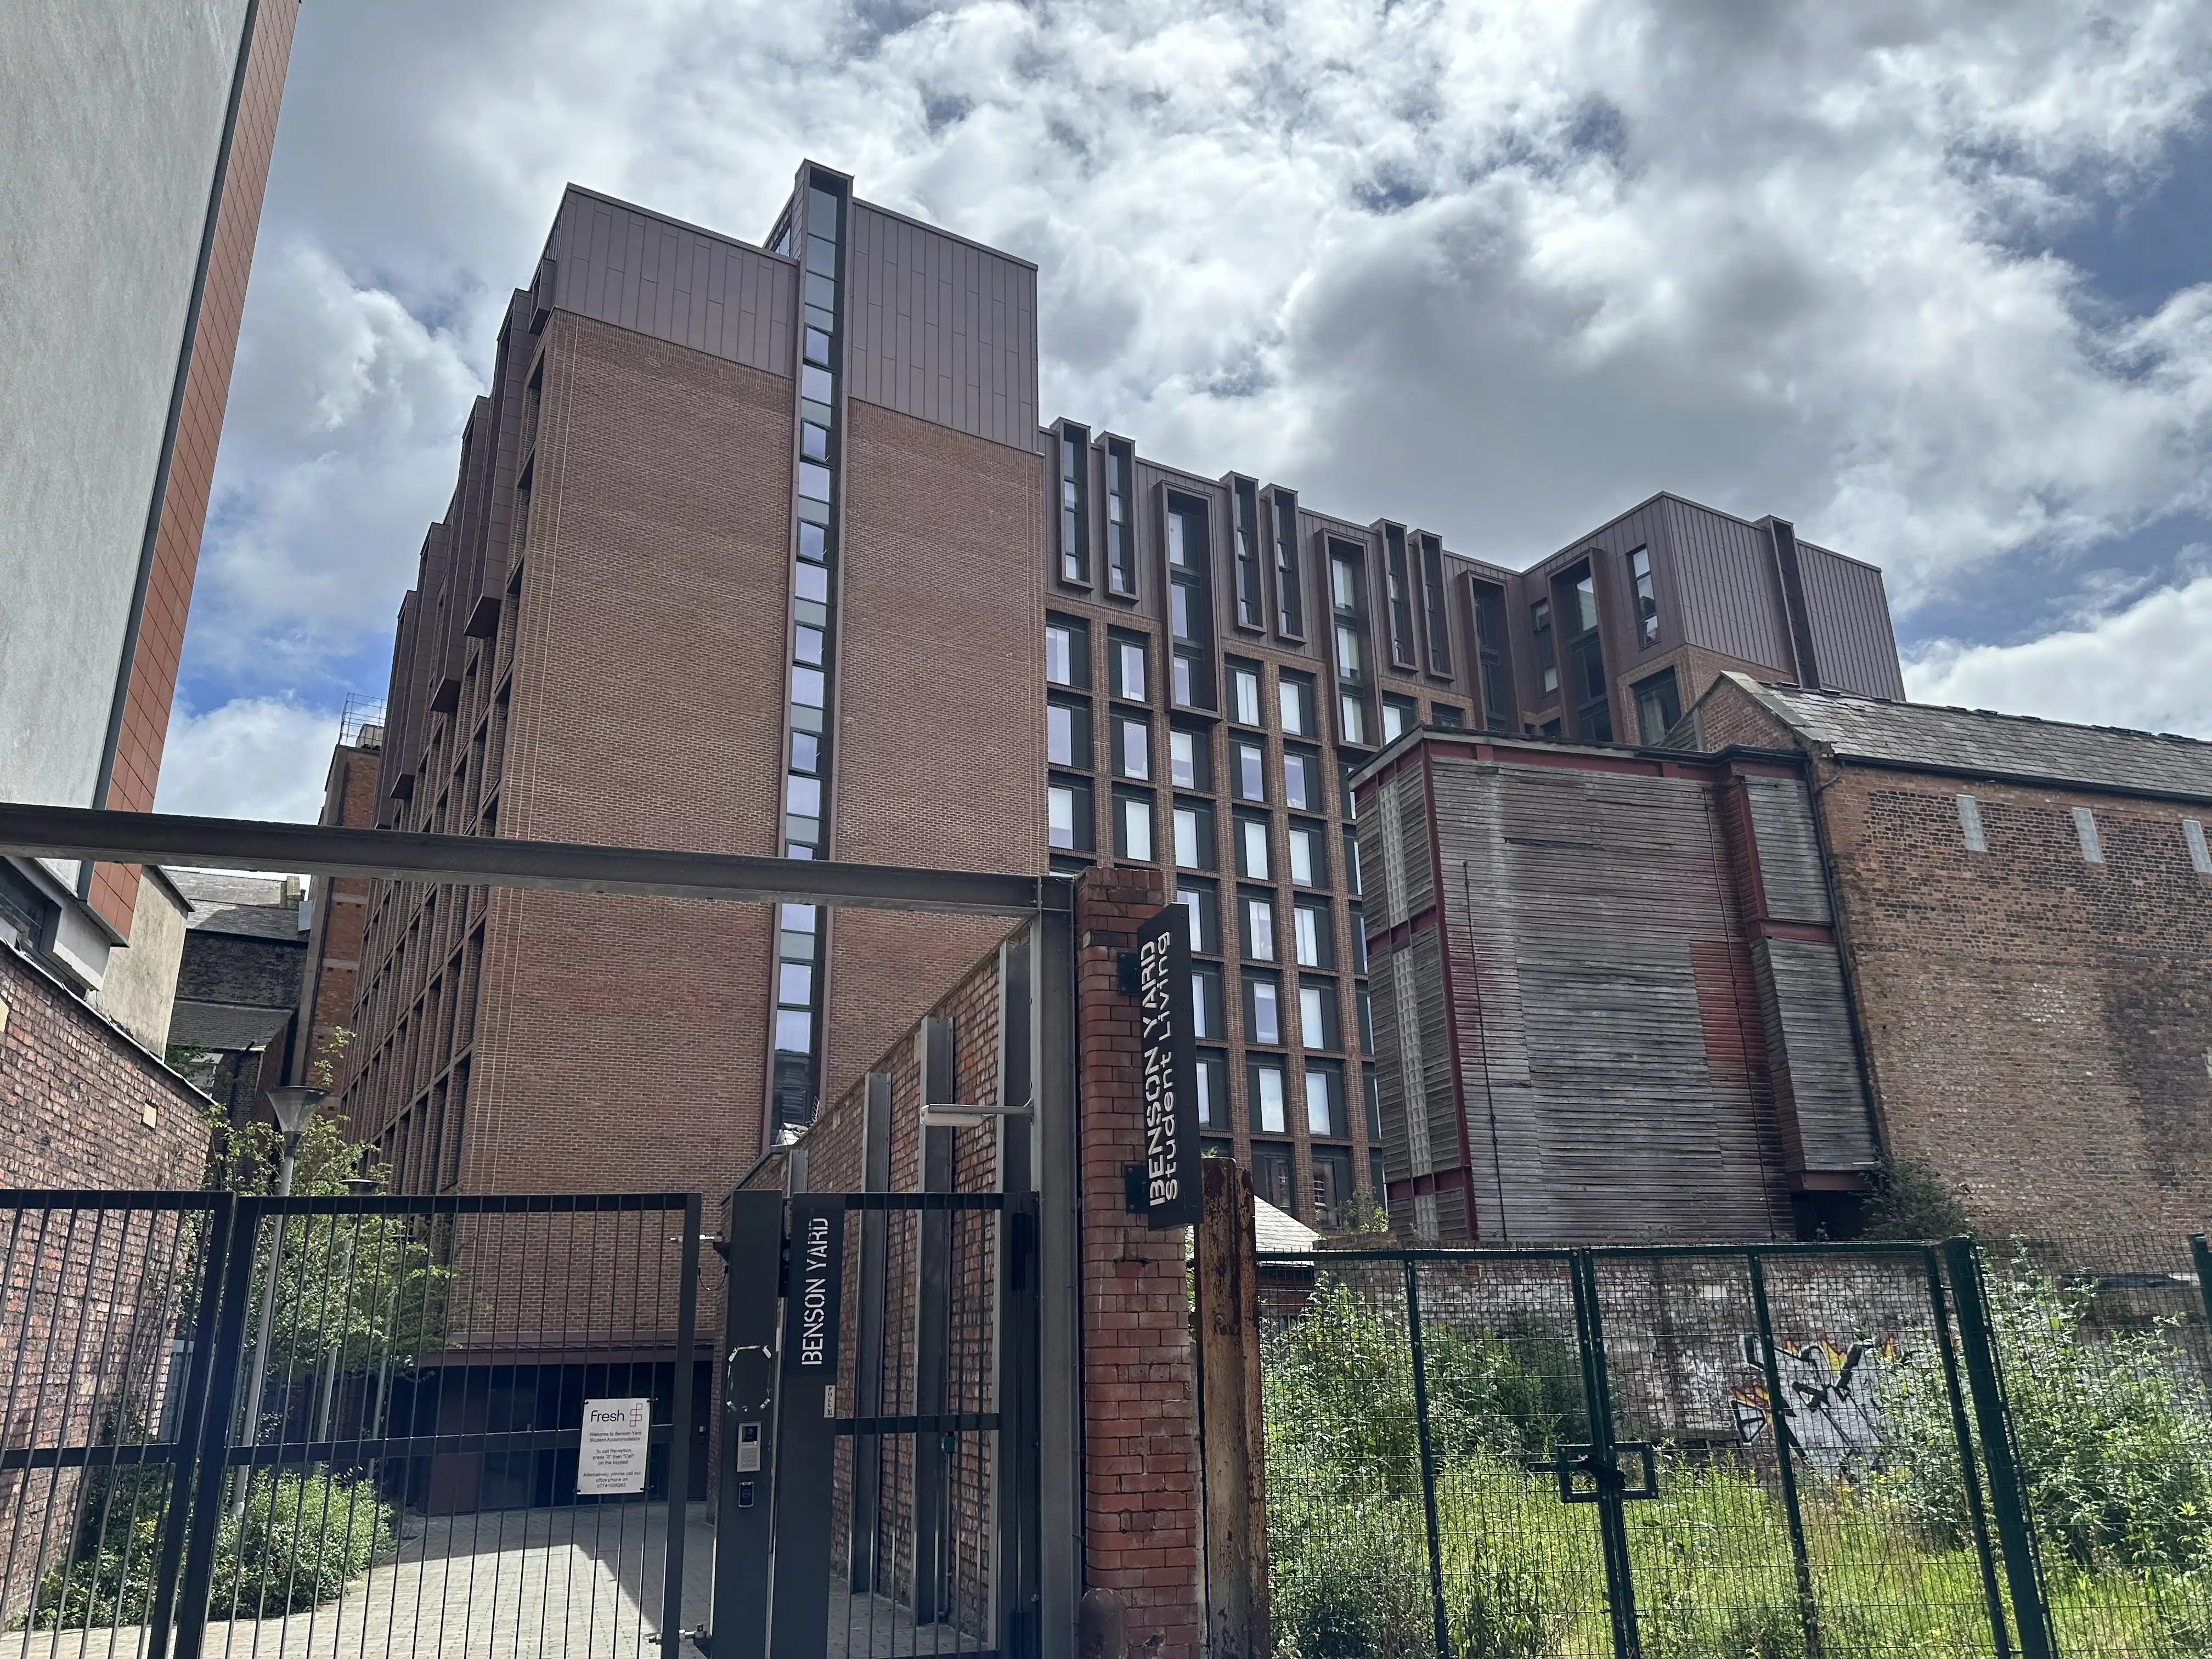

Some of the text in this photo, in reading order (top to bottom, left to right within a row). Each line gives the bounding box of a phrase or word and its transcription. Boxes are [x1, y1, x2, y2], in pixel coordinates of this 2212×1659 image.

[1141, 941, 1165, 1206] BENSON YARD
[1157, 932, 1178, 1200] Student Living
[802, 1218, 828, 1365] BENSON YARD
